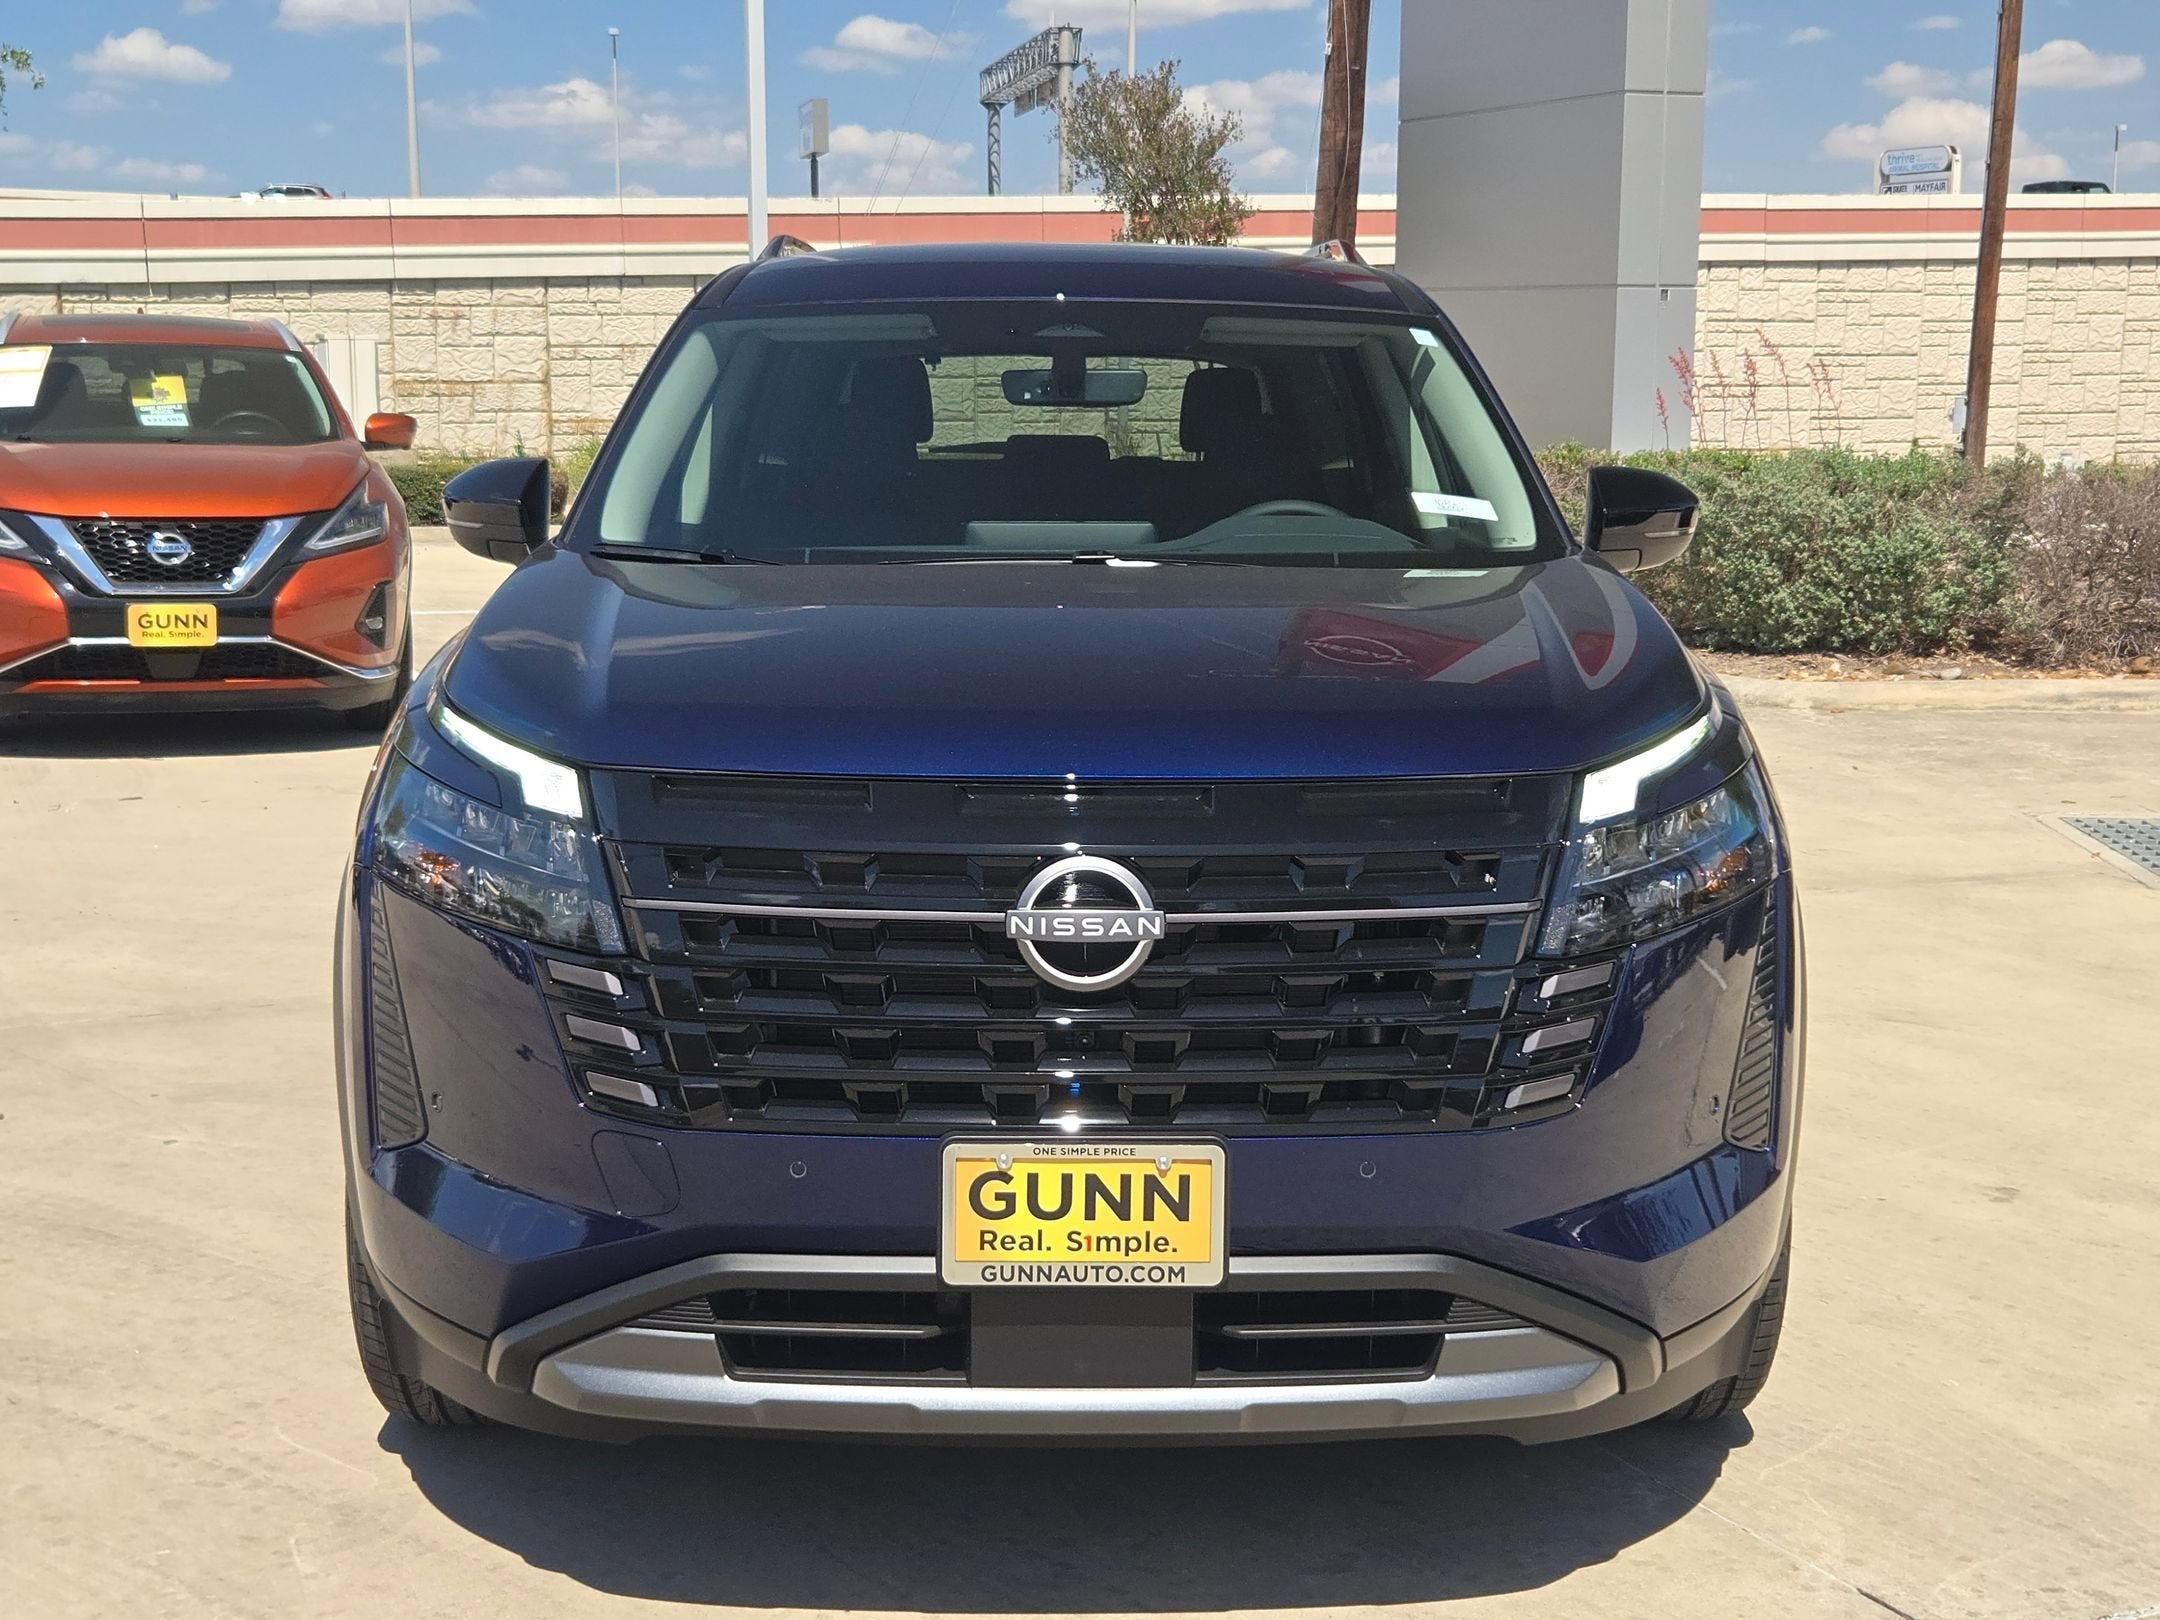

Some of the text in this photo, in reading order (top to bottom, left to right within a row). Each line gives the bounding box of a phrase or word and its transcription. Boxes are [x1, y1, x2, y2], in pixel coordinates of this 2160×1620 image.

[1887, 152, 1915, 165] thrive
[1914, 181, 1946, 193] MAYFAIR
[138, 613, 208, 629] GUNN
[142, 630, 166, 638] Real.
[1010, 916, 1161, 937] NISSAN
[1032, 1146, 1137, 1156] ONE SIMPLE PRICE
[968, 1170, 1191, 1222] GUNN
[979, 1229, 1052, 1252] Real.
[981, 1265, 1186, 1283] GUNNAUTO.COM
